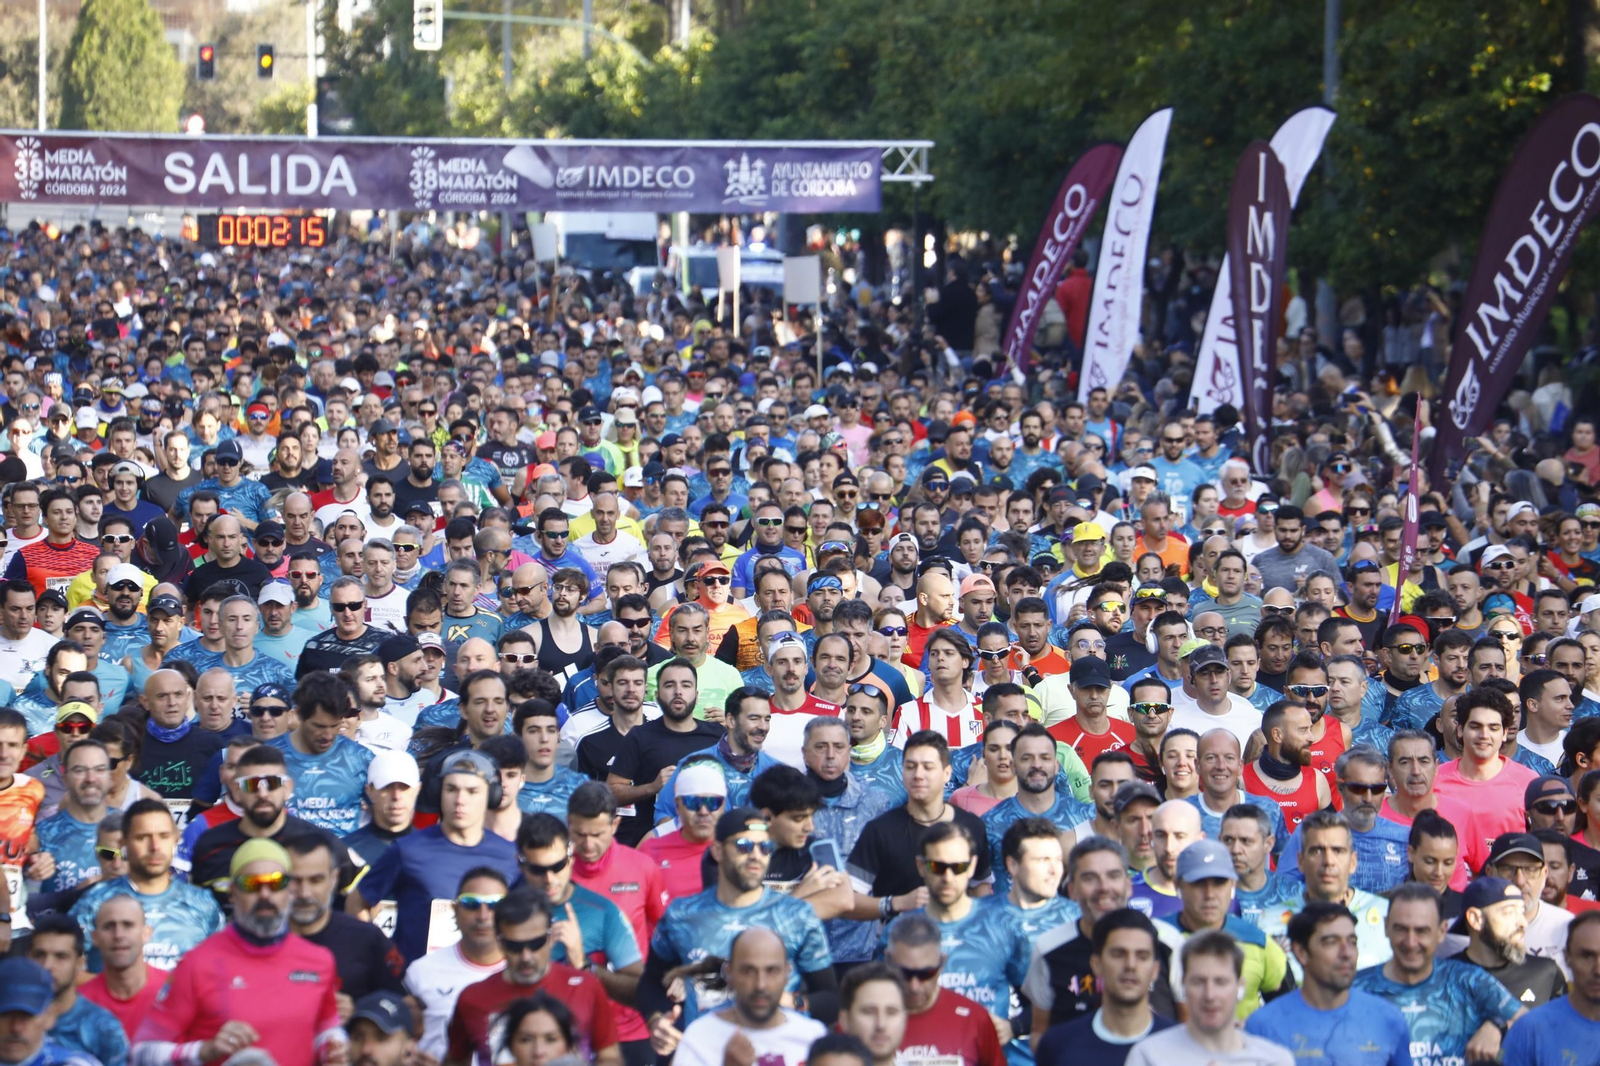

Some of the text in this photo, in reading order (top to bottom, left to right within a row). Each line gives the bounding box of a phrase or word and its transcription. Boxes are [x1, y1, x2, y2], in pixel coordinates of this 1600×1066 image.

[45, 148, 95, 165] MEDIA
[438, 157, 488, 174] MEDIA
[14, 159, 44, 181] 38
[45, 160, 127, 181] MARATÓN
[164, 152, 358, 197] SALIDA
[588, 166, 695, 188] IMDECO
[771, 161, 872, 179] AYUNTAMIENTO
[409, 168, 439, 191] 38
[438, 169, 518, 190] MARATÓN
[771, 179, 788, 197] DE
[45, 182, 127, 196] CÓRDOBA 2024
[490, 191, 517, 204] 2024
[1464, 122, 1600, 361] IMDECO
[815, 702, 836, 710] RESCUE
[297, 797, 336, 809] MEDIA
